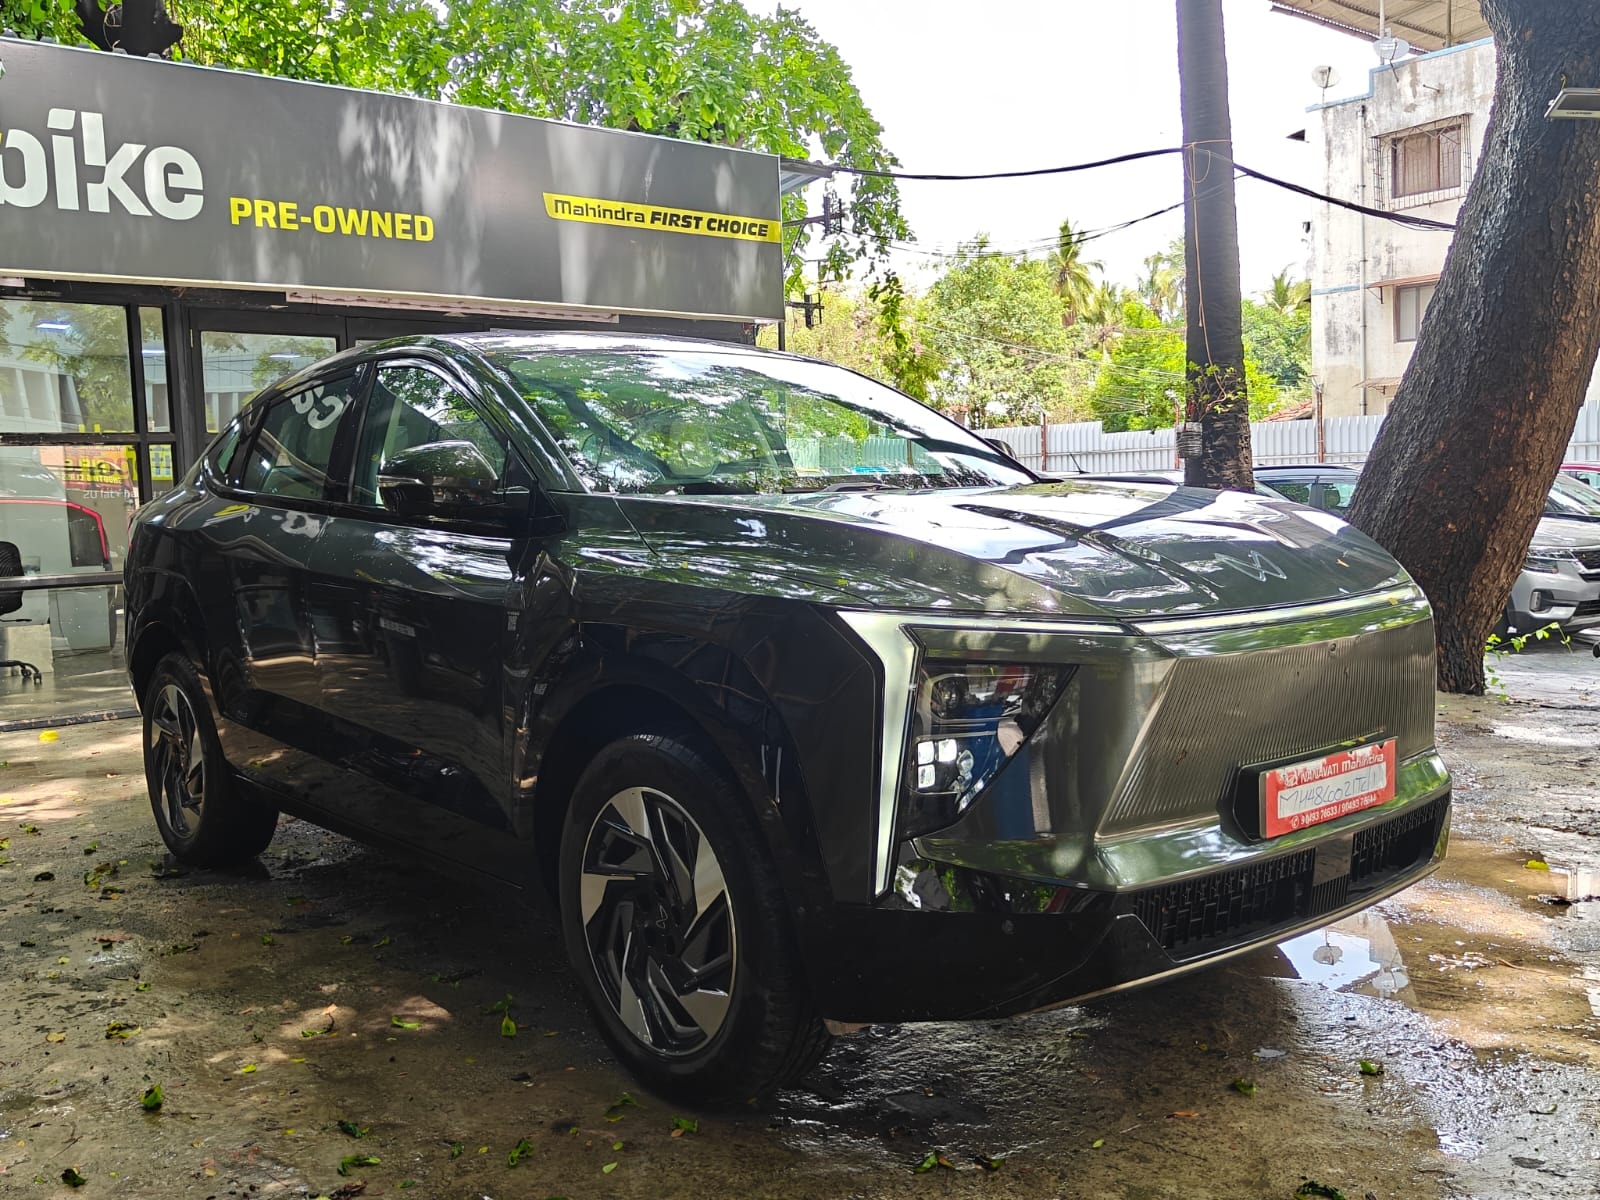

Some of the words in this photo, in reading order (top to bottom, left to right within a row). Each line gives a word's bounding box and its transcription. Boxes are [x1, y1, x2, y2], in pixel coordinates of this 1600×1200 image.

[229, 197, 435, 242] PRE-OWNED
[650, 210, 704, 230] FIRST
[706, 217, 769, 237] CHOICE
